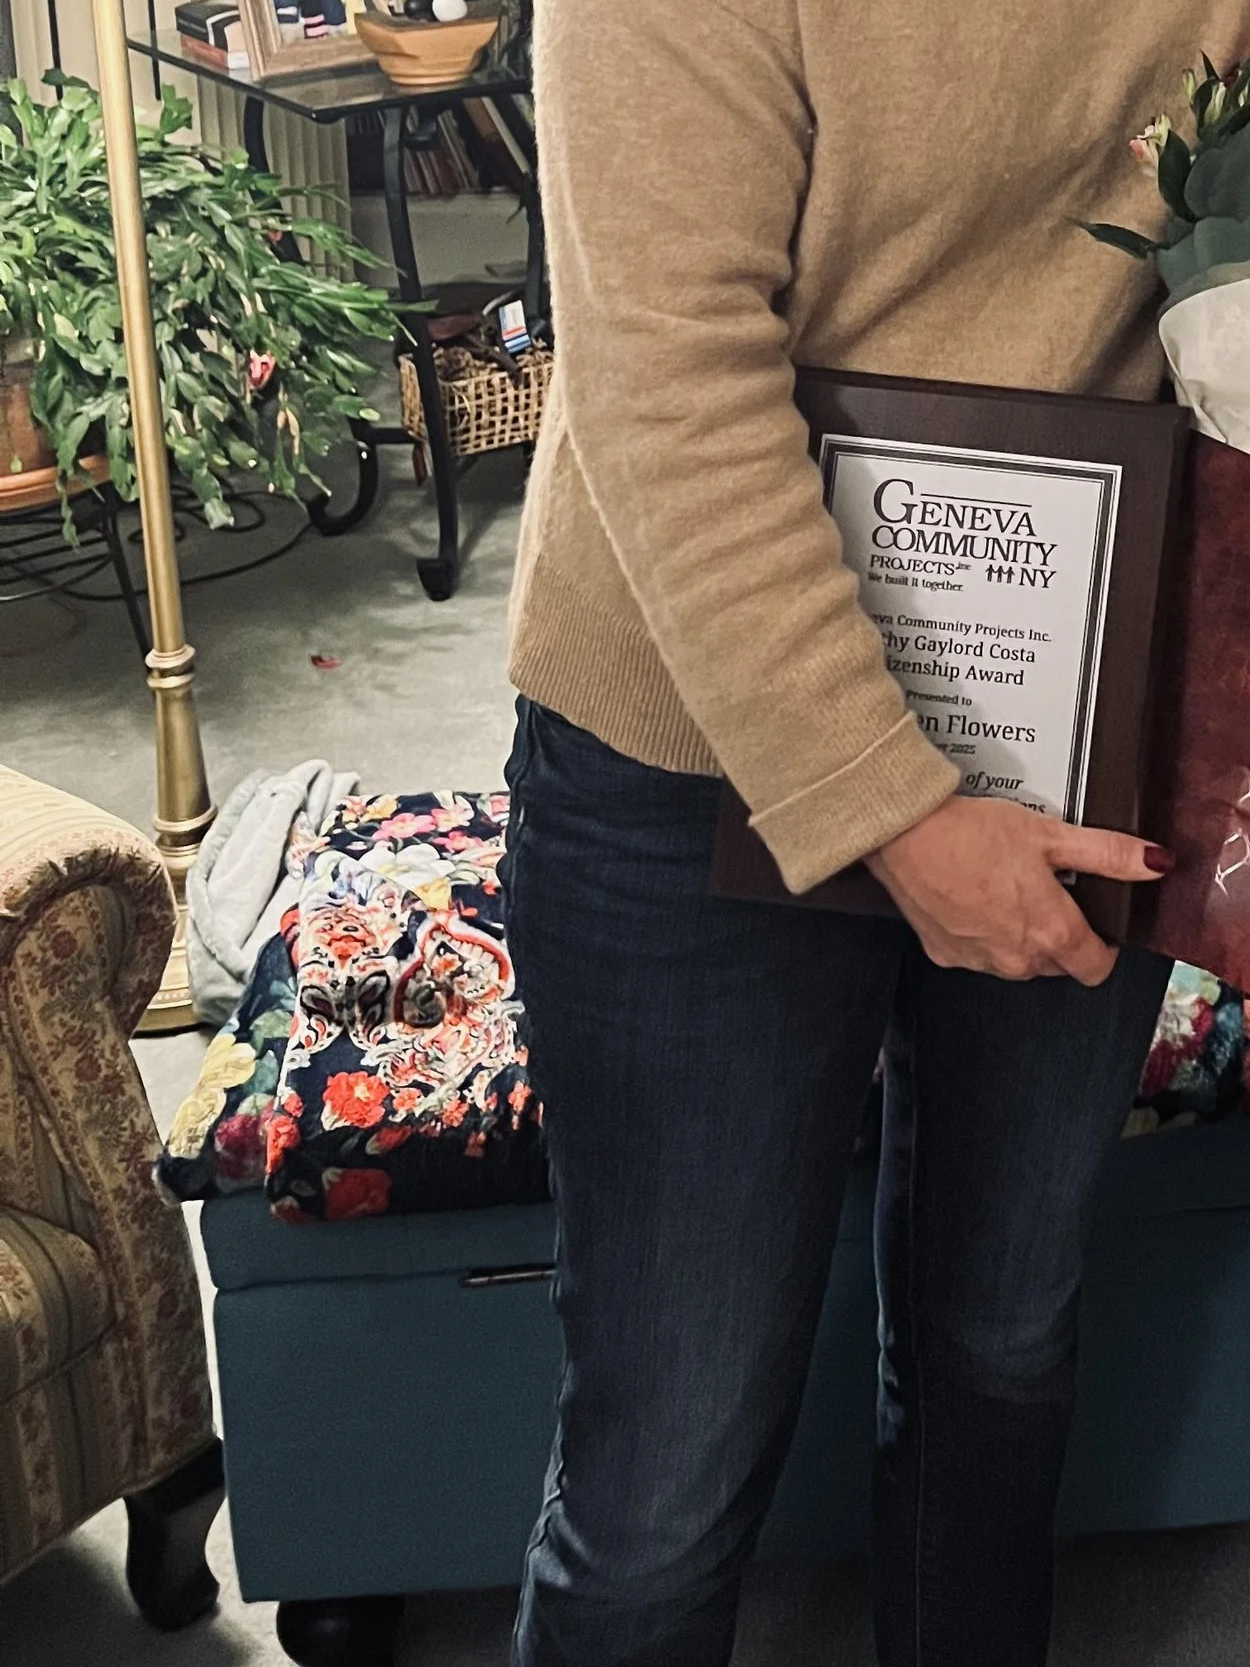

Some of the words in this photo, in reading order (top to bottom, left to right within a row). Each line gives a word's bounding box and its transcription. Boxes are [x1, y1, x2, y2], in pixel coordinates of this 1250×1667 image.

[873, 478, 1037, 537] GENEVA
[871, 525, 1058, 566] COMMUNITY
[870, 554, 955, 576] PROJECTS
[1019, 567, 1057, 589] NY
[897, 614, 972, 636] Community
[975, 623, 1025, 640] Projects
[1028, 629, 1052, 642] Inc.
[914, 635, 984, 657] Gaylord
[989, 643, 1035, 663] Costa
[888, 655, 960, 683] izenship
[964, 665, 1025, 685] Award
[961, 695, 972, 707] to
[948, 714, 1036, 743] Flowers
[966, 771, 984, 789] of
[981, 777, 1024, 791] your
